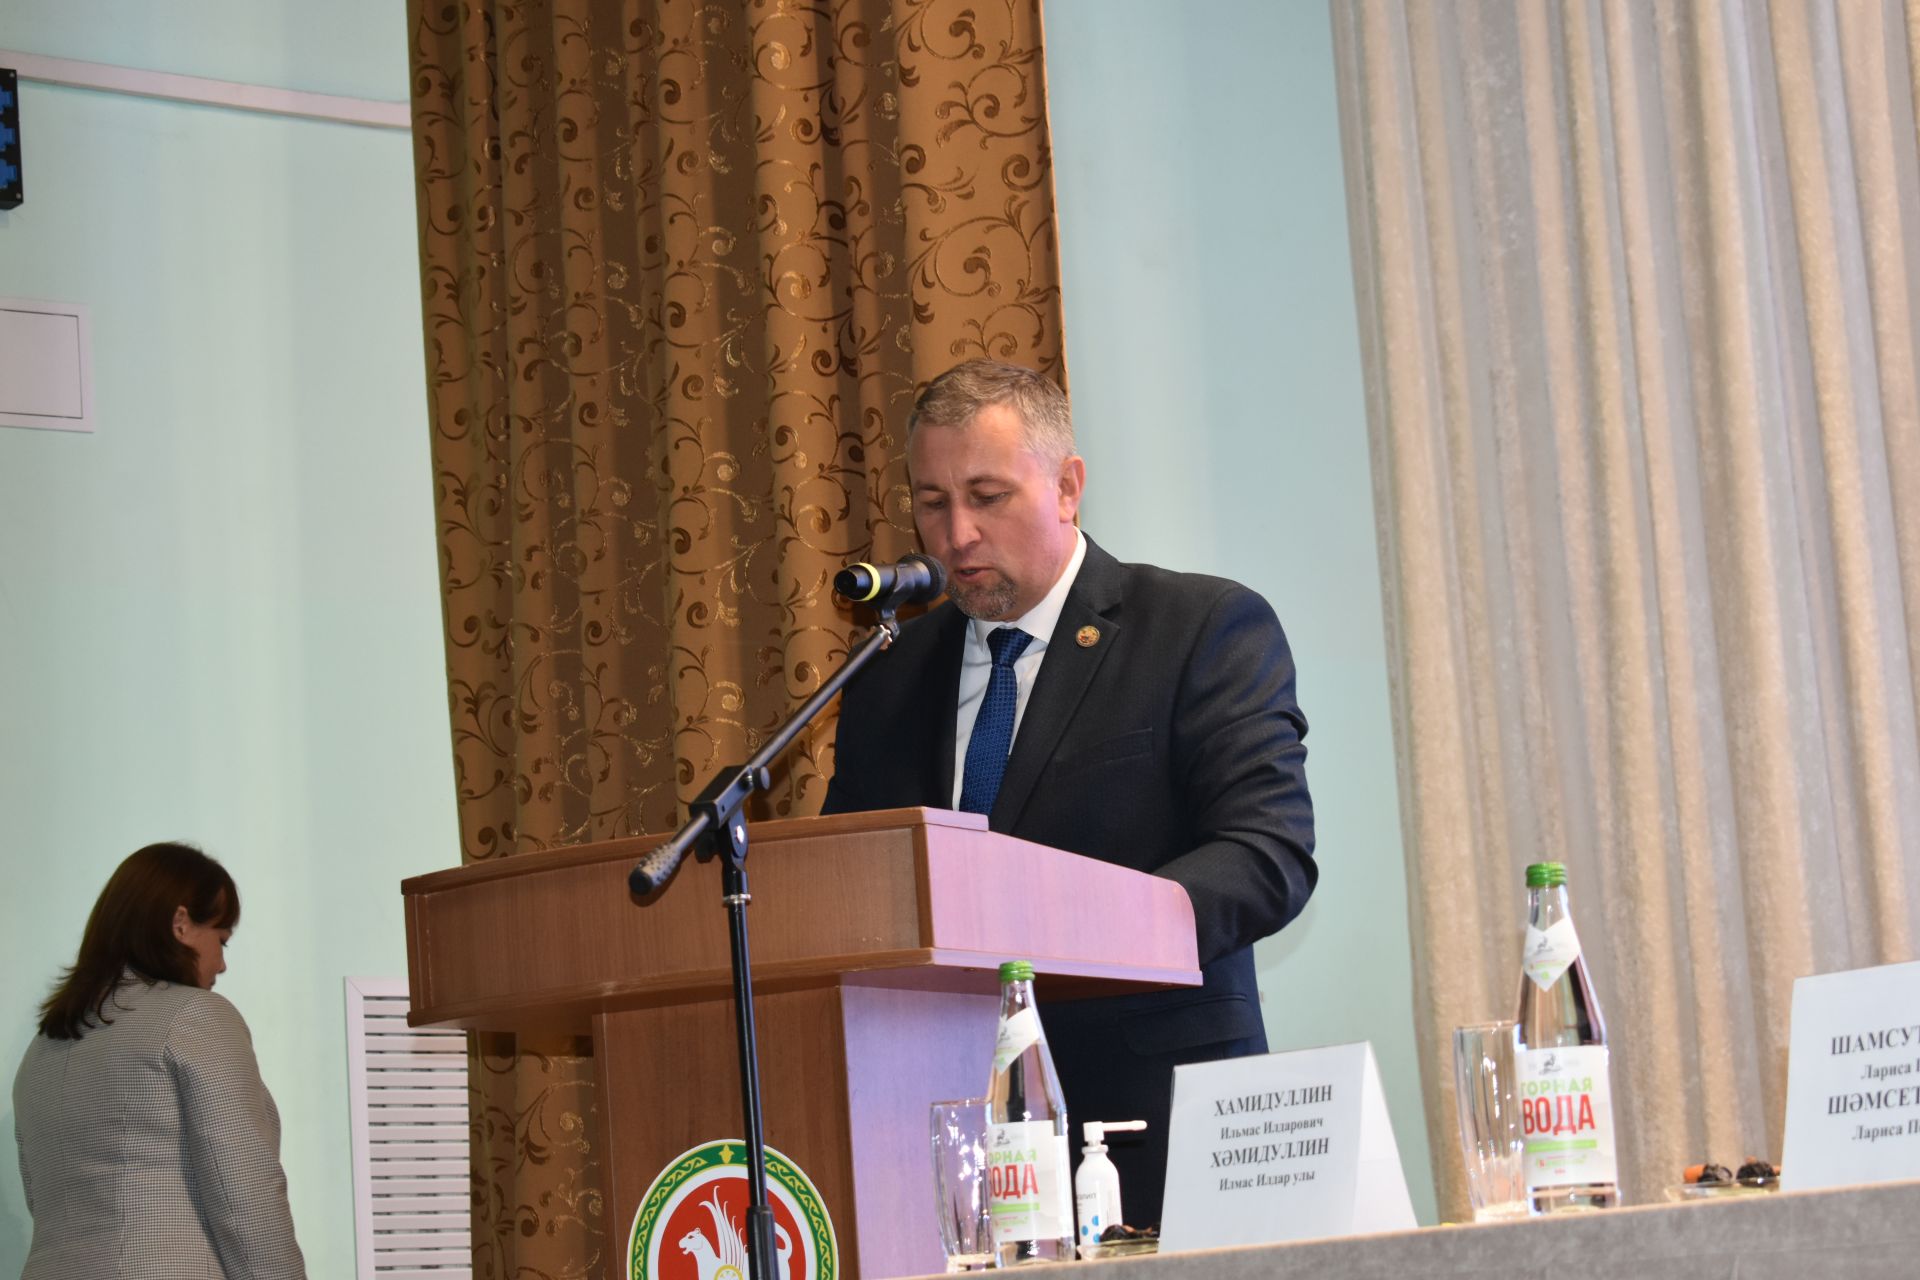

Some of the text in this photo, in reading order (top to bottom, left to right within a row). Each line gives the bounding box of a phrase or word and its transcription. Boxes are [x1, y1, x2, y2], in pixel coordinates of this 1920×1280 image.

[1860, 1063, 1911, 1081] Лариса
[1520, 1077, 1592, 1097] ГОРНАЯ
[1213, 1084, 1332, 1117] ХАМИДУЛЛИН
[1522, 1094, 1596, 1136] ВОДА
[1220, 1117, 1324, 1140] Ильмас Илдарович
[1851, 1124, 1903, 1143] Лариса
[1210, 1137, 1330, 1168] ХӘМИДУЛЛИН
[1219, 1170, 1315, 1191] Илмас Илдар улы
